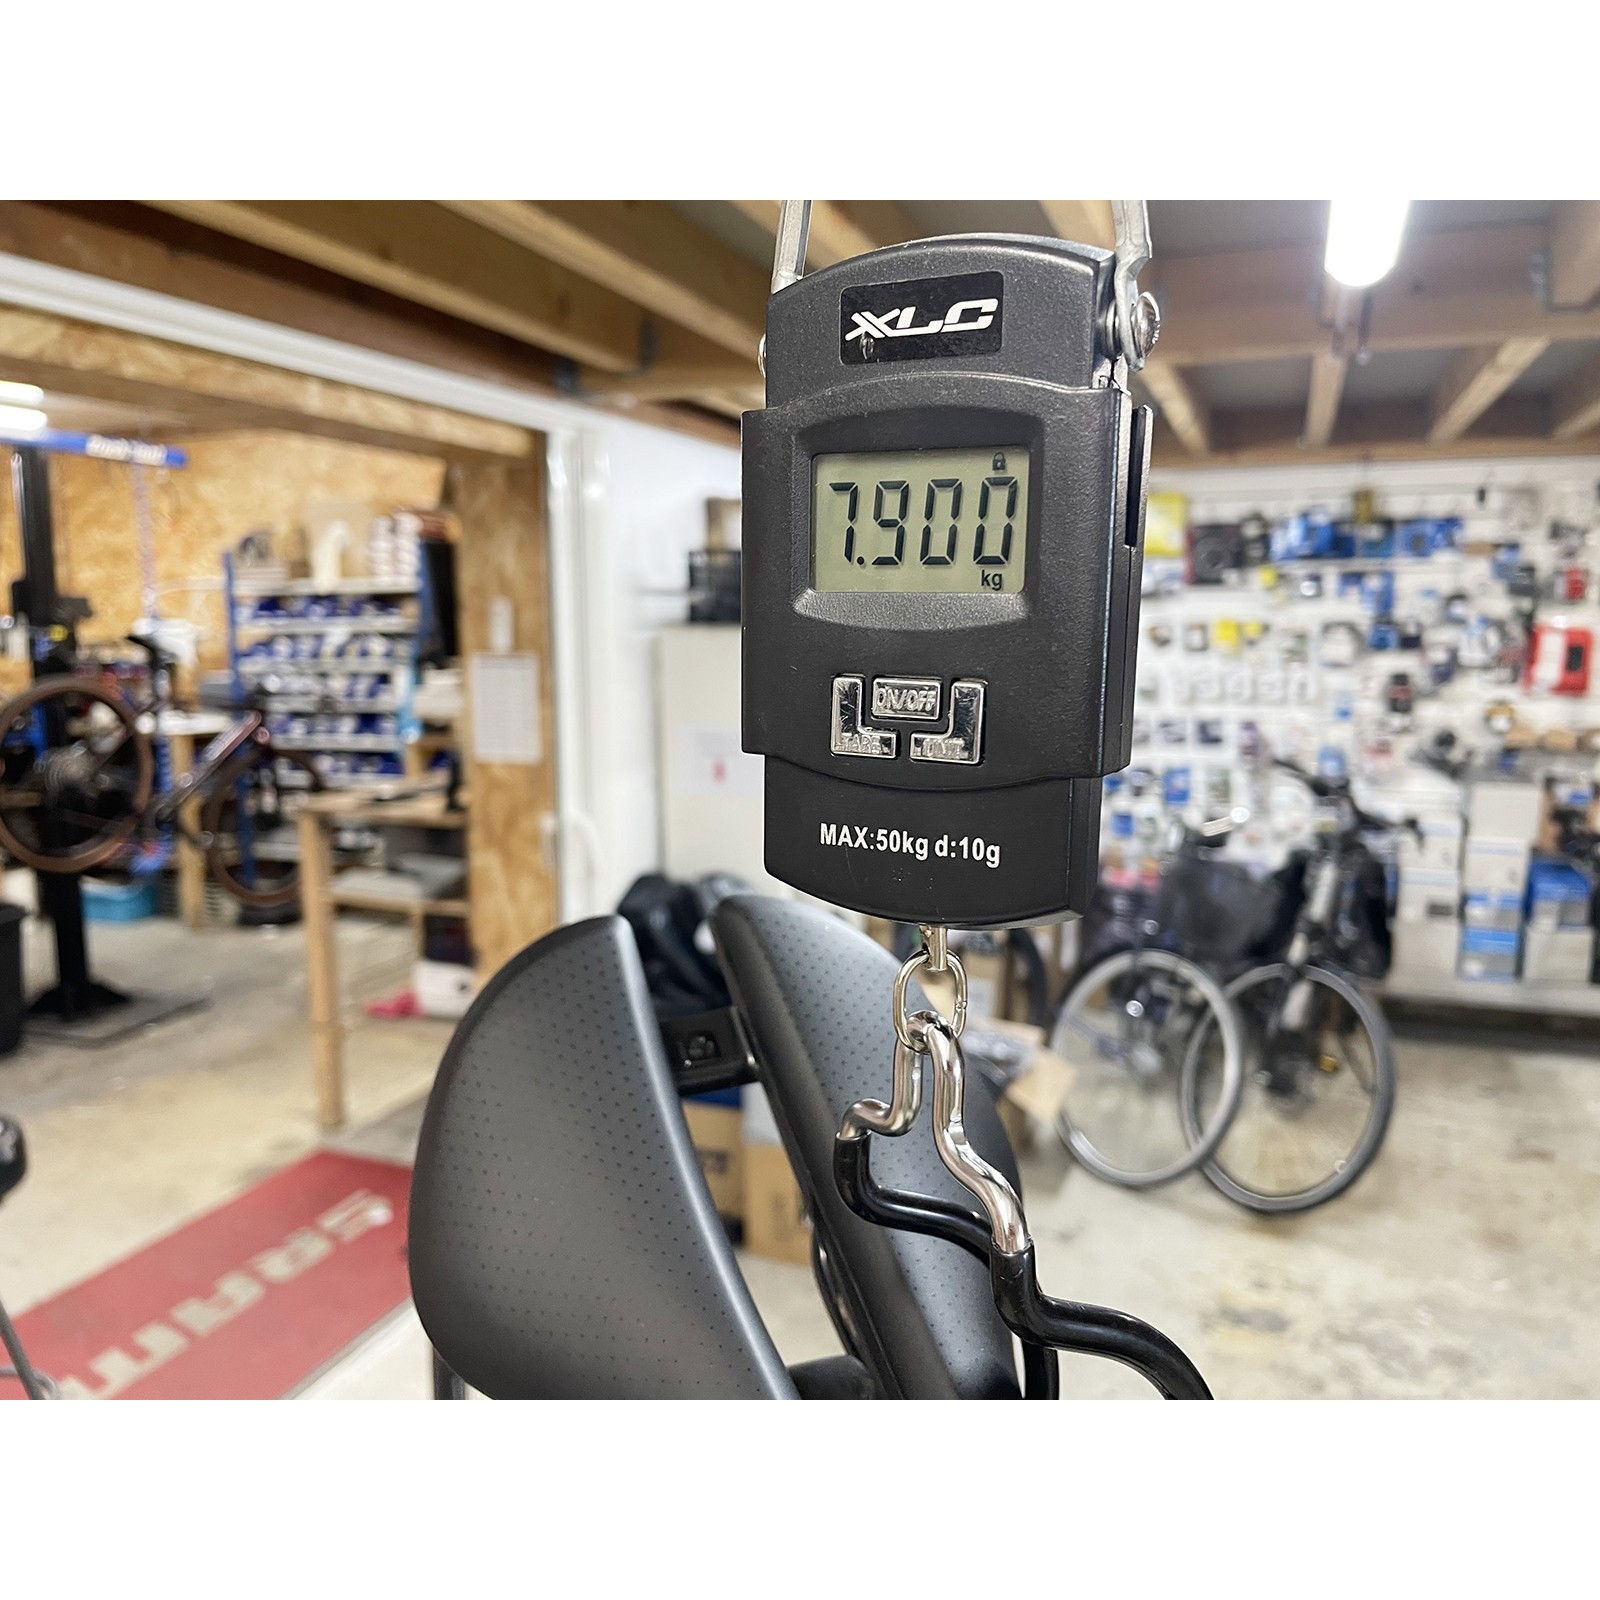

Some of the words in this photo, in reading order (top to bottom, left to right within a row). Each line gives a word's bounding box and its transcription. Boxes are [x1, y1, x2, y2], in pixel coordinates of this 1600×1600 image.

[845, 298, 998, 341] XLC
[829, 476, 1018, 565] 7.900
[980, 569, 1003, 590] kg
[876, 687, 937, 712] ON/OFF
[820, 822, 929, 861] MAX:50kg
[934, 834, 1001, 869] d:10g
